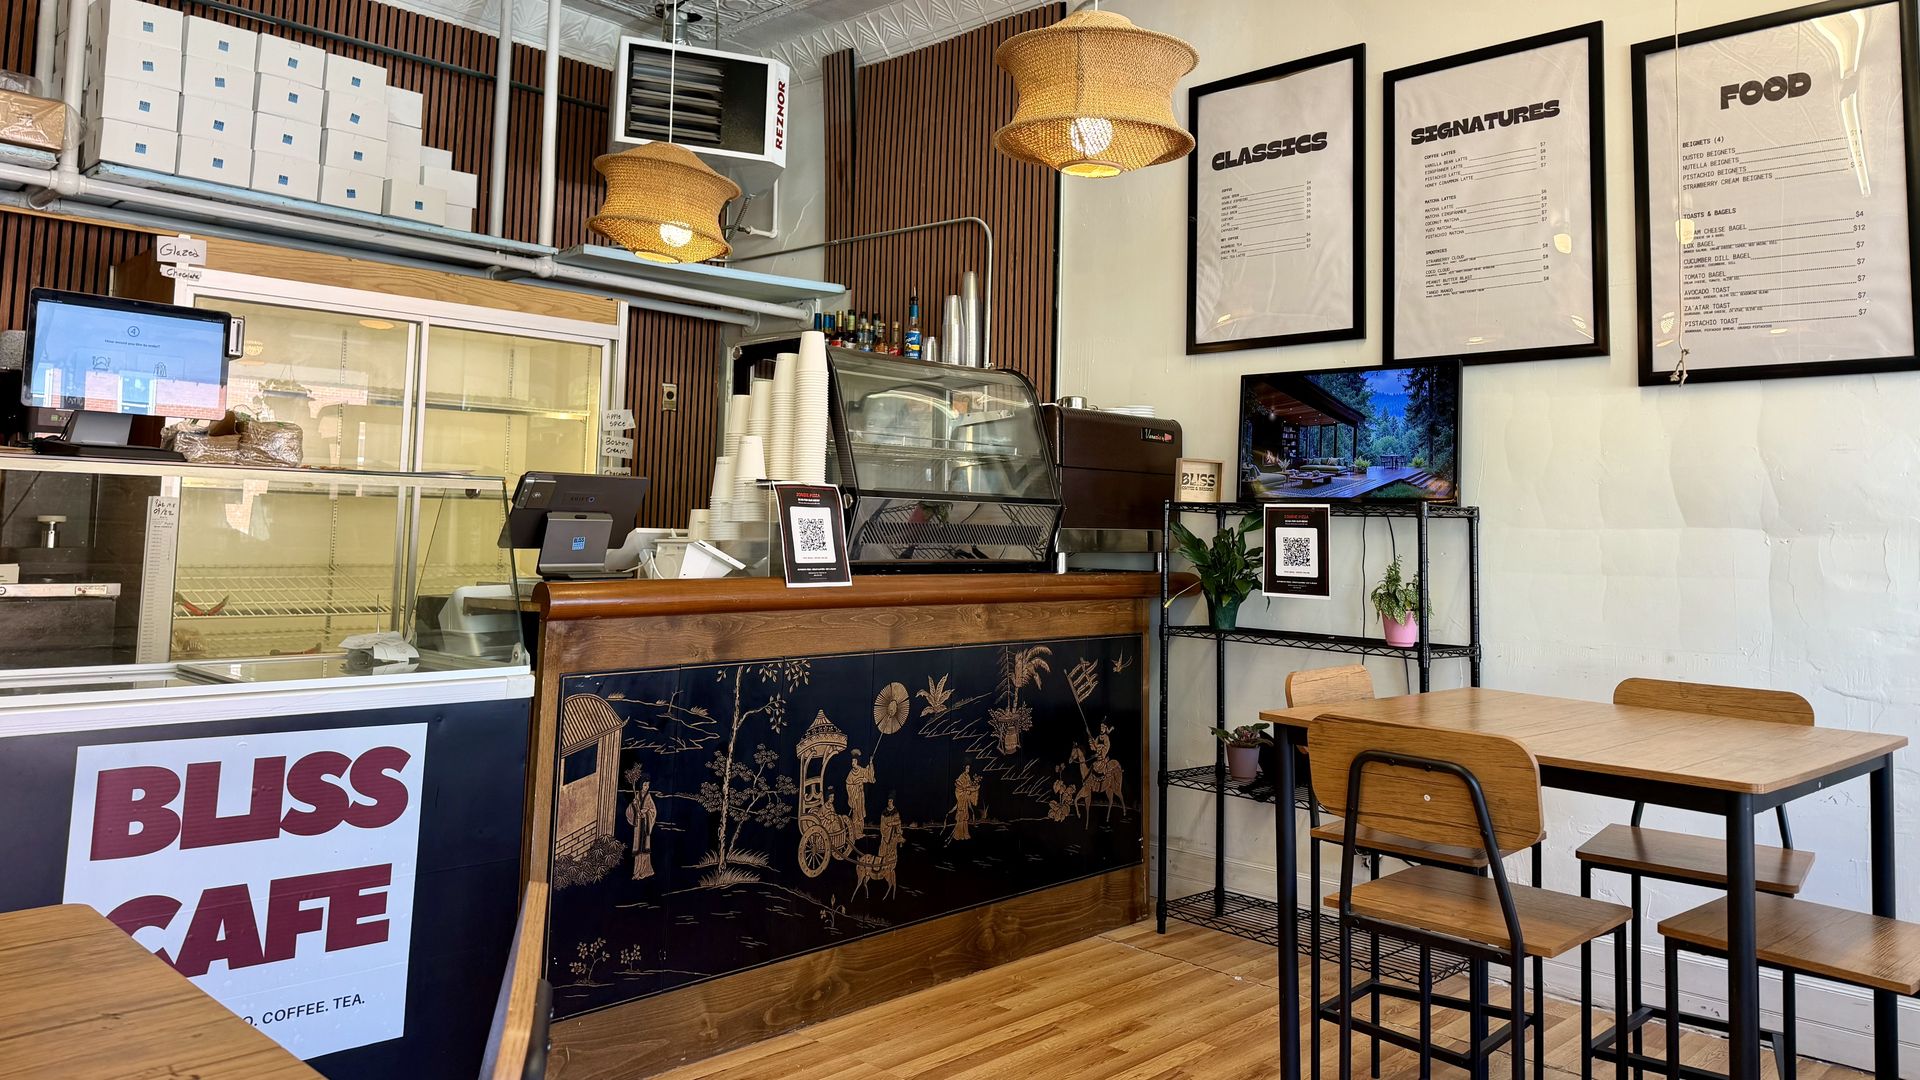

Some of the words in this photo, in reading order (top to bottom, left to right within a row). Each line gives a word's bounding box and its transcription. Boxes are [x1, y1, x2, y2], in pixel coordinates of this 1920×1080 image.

[1720, 72, 1811, 110] FOOD
[776, 81, 785, 149] REZNOR
[1411, 100, 1560, 145] SIGNATURES
[1683, 139, 1710, 148] BEIGNETS
[1212, 132, 1327, 171] CLASSICS
[1683, 152, 1704, 161] DUSTED
[1707, 148, 1735, 157] BEIGNETS
[1683, 161, 1707, 171] NUTELLA
[1710, 157, 1739, 167] BEIGNETS
[1683, 170, 1714, 180] PISTACHIO
[1717, 166, 1746, 176] BEIGNETS
[1683, 180, 1717, 190] STRAWBERRY
[1721, 177, 1740, 185] CREAM
[1743, 173, 1772, 182] BEIGNETS
[1683, 211, 1704, 219] TOASTS
[1714, 208, 1736, 216] BAGELS
[1704, 226, 1725, 234] CHEESE
[1729, 224, 1747, 232] BAGEL
[160, 243, 200, 257] Glazed
[1697, 240, 1715, 248] BAGEL
[1683, 256, 1711, 264] CUCUMBER
[1714, 254, 1728, 262] DILL
[1733, 252, 1751, 260] BAGEL
[167, 268, 200, 279] Chocolate
[1685, 272, 1705, 280] TOMATO
[1684, 288, 1709, 296] AVOCADO
[1857, 274, 1865, 282] $7
[1685, 318, 1717, 327] PISTACHIO
[1859, 308, 1867, 316] $7
[1182, 473, 1215, 487] BLISS
[89, 746, 411, 861] BLISS
[106, 863, 392, 978] CAFE
[262, 1001, 328, 1024] COFFEE.
[333, 994, 365, 1009] TEA.
